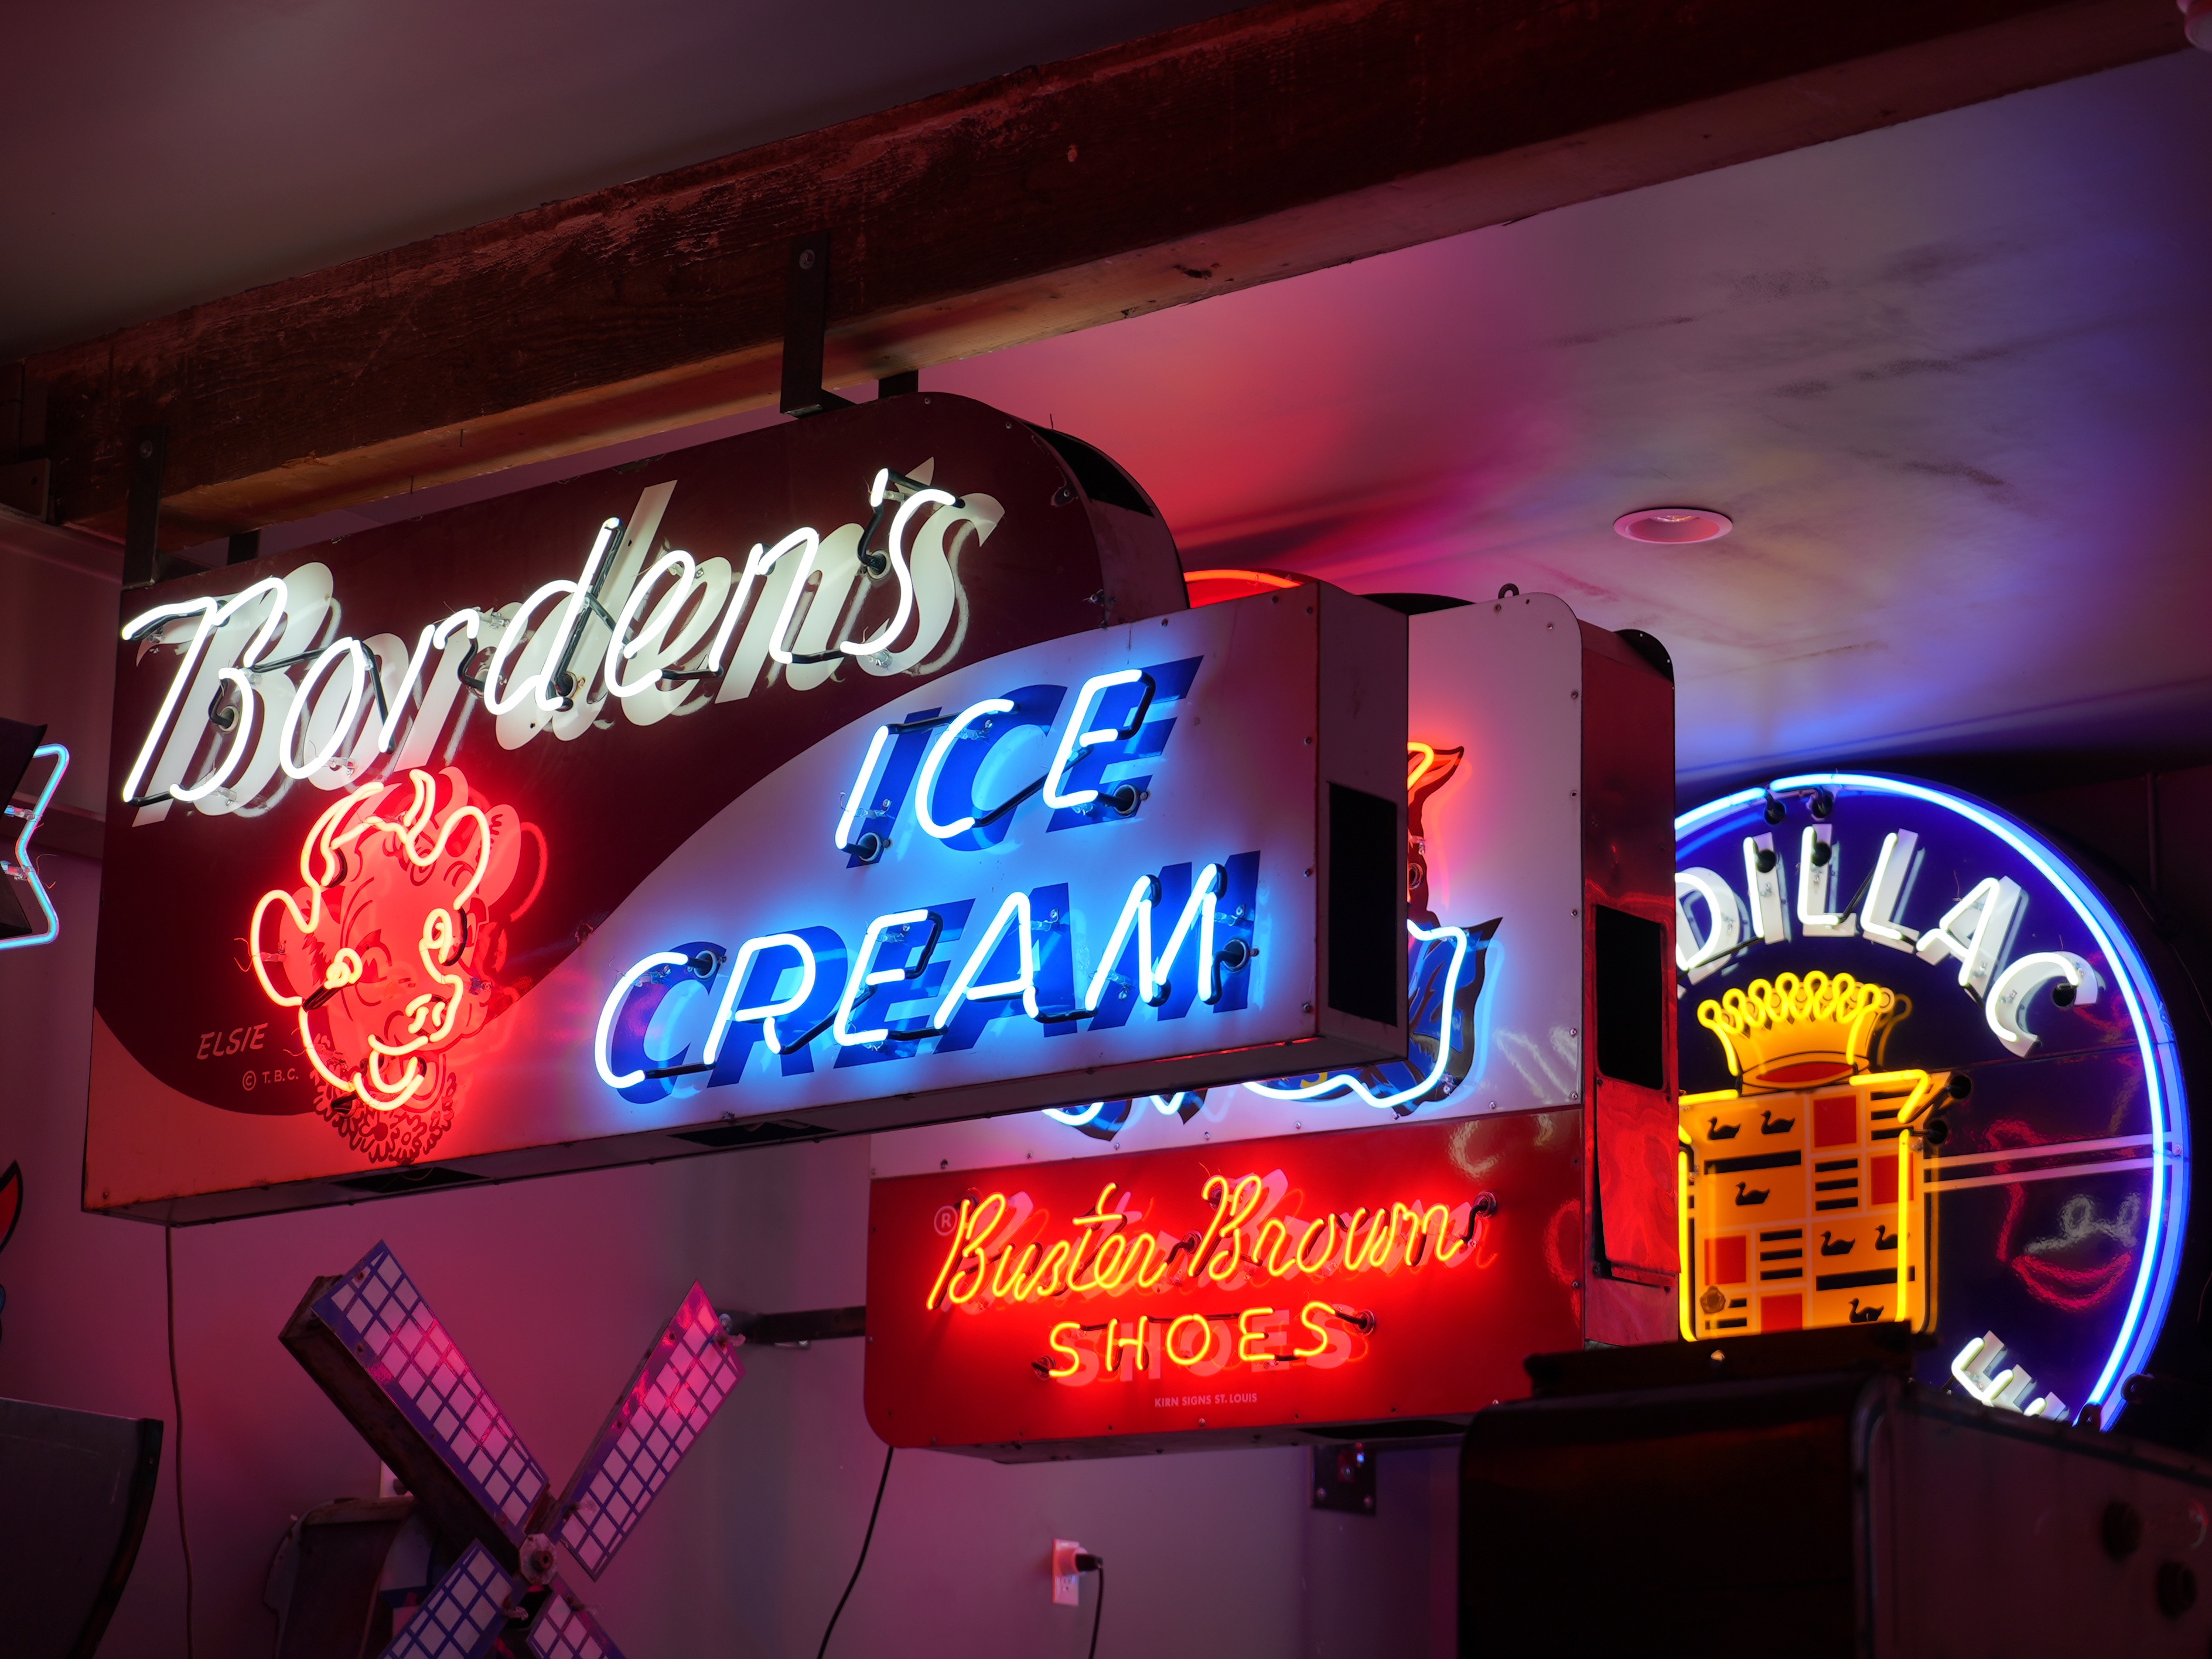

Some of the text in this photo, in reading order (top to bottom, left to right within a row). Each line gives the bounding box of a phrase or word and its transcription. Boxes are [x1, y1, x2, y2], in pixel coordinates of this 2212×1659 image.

[122, 457, 1005, 827] Borden's
[835, 655, 1204, 868] ICE
[594, 851, 1260, 1104] CREAM
[1674, 823, 2100, 1057] DILLAC
[196, 1022, 268, 1060] ELSIE
[927, 1182, 1173, 1313] Buster
[1189, 1170, 1477, 1289] Brown
[1049, 1301, 1351, 1386] SHOES
[1154, 1392, 1258, 1407] KIRN SIGNS ST. LOUIS
